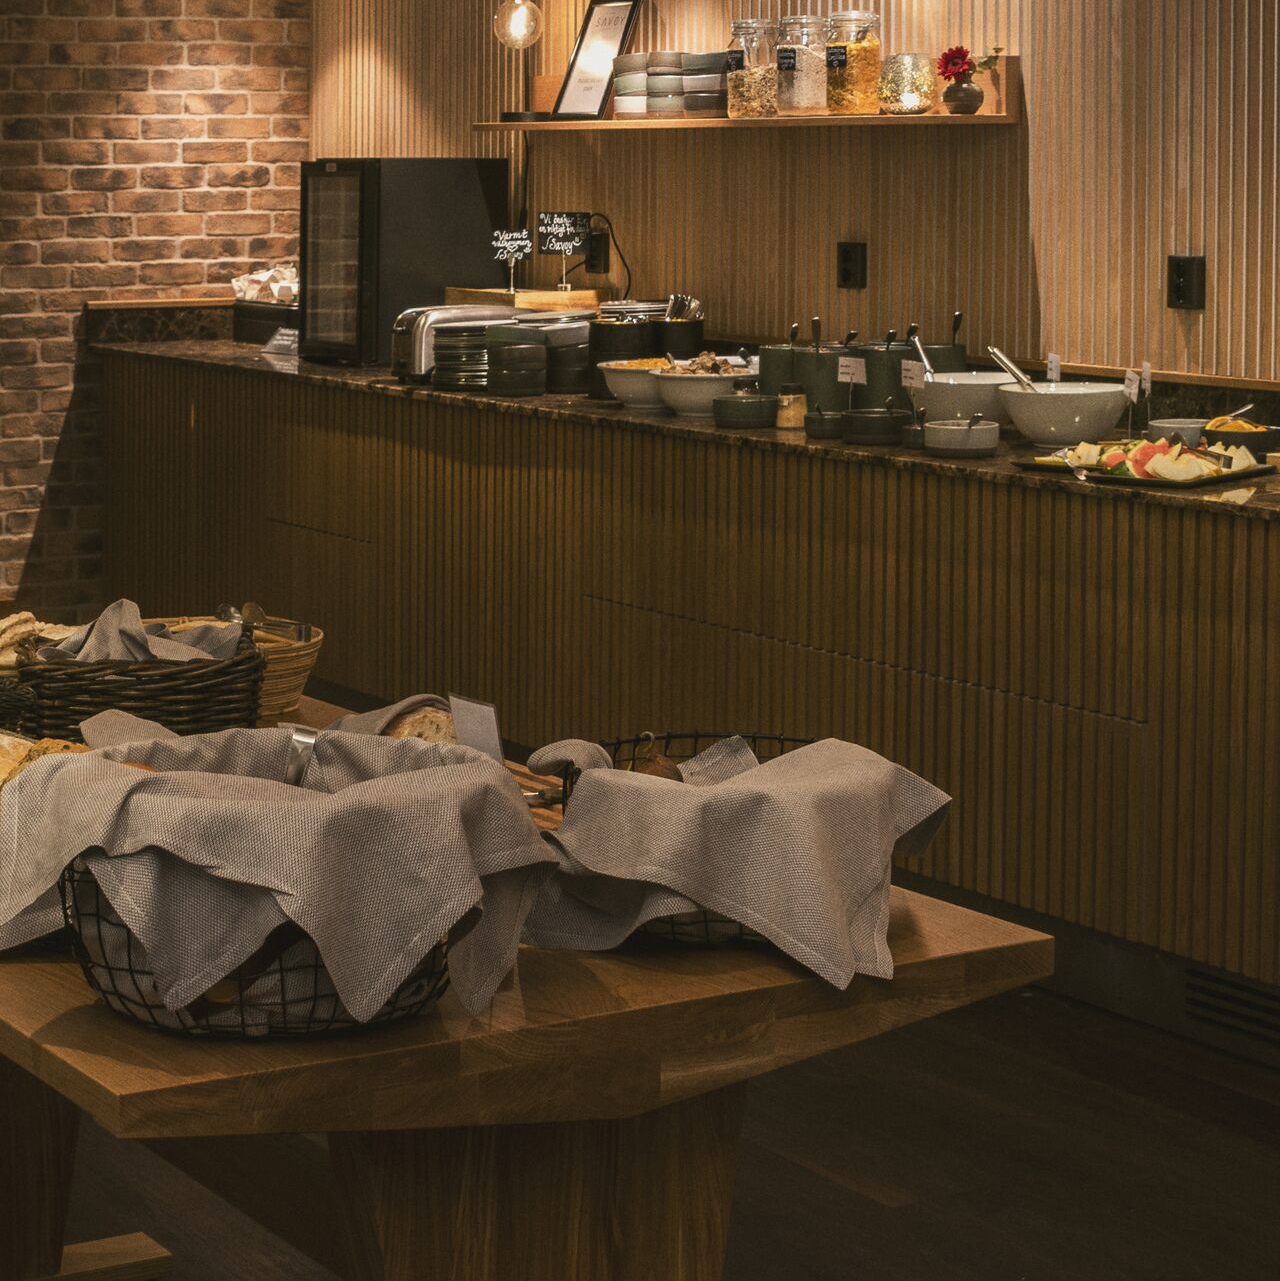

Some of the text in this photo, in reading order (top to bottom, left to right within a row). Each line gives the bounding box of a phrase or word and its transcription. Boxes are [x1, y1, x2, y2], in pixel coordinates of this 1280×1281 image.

[595, 15, 625, 28] SAVOY
[539, 213, 551, 224] Vi
[493, 229, 528, 240] Varmt
